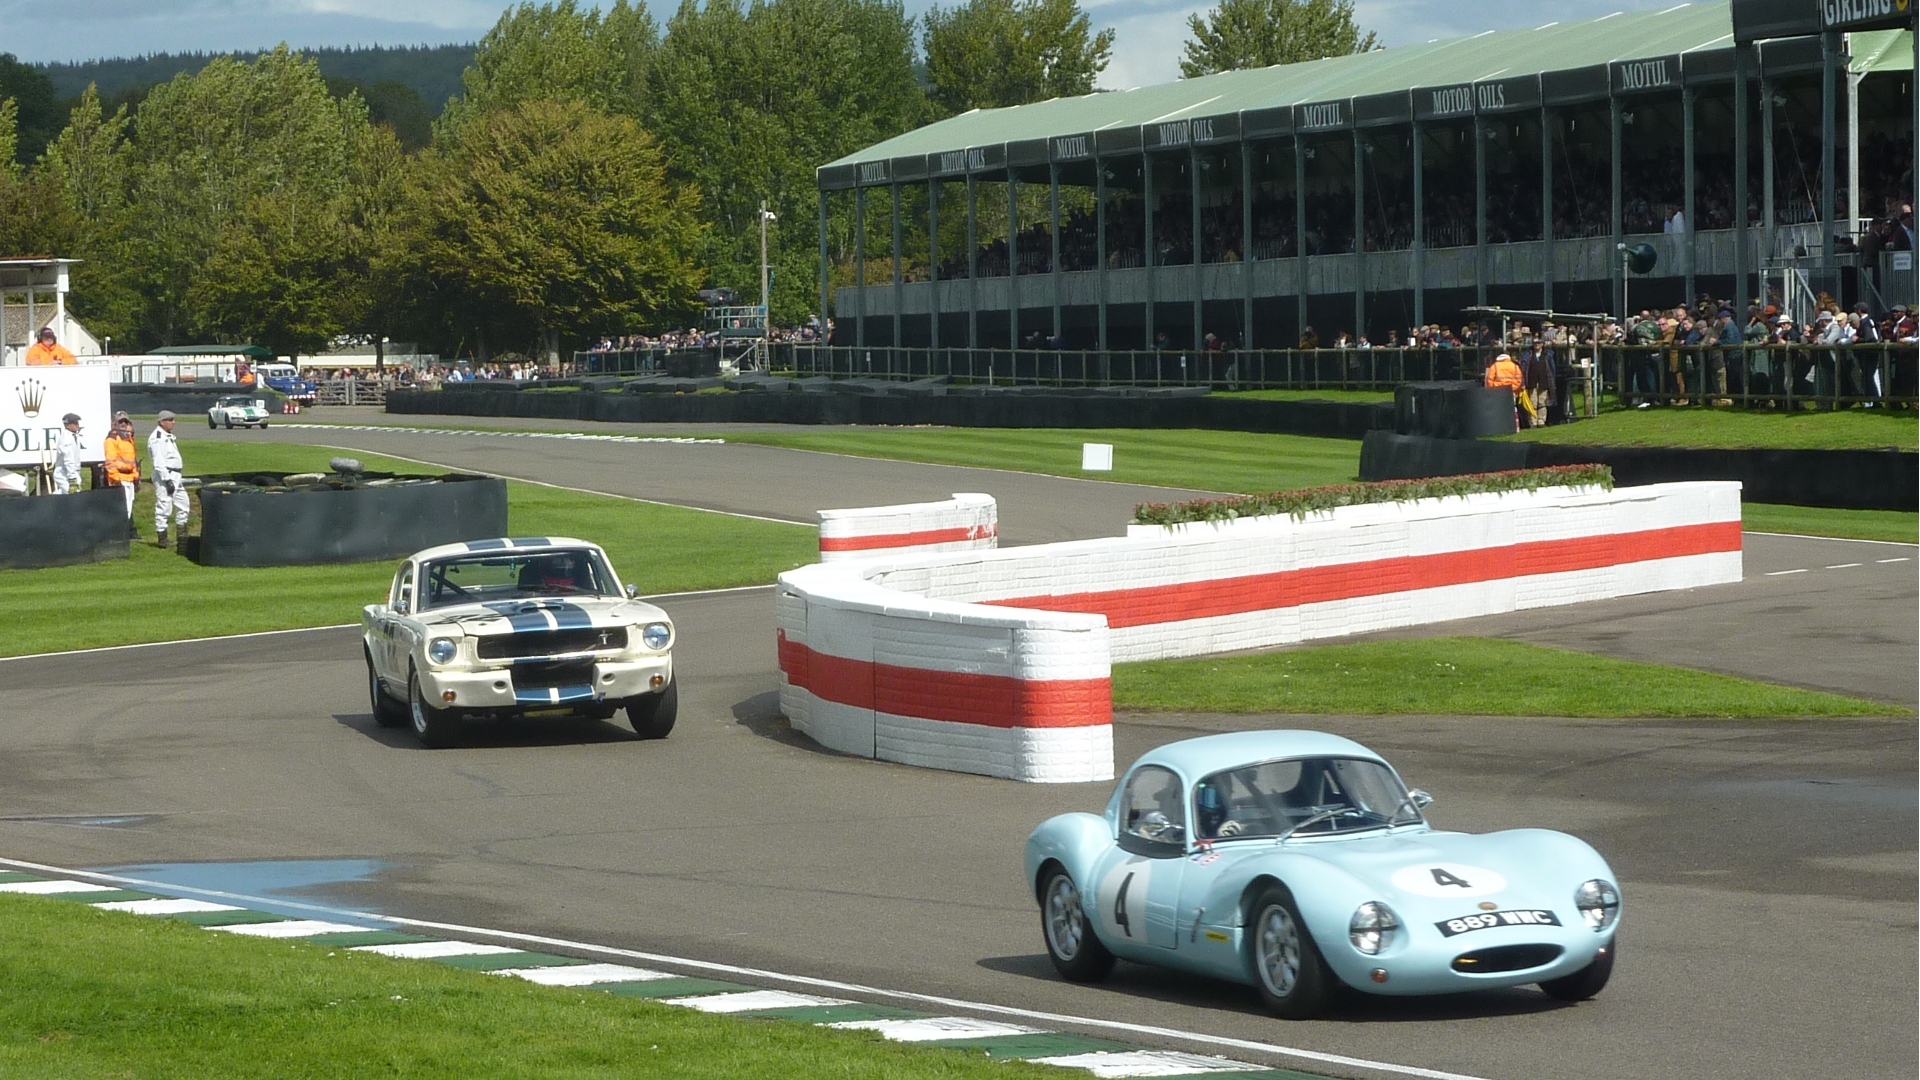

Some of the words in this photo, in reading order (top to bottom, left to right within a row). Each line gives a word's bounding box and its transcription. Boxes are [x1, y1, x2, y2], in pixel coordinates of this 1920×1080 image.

[1823, 0, 1891, 26] GIRLING
[1621, 60, 1670, 90] MOTUL
[1432, 87, 1472, 115] MOTOR
[1478, 84, 1505, 110] OILS
[1303, 103, 1343, 129] MOTUL
[1159, 121, 1190, 147] MOTOR
[1193, 119, 1214, 142] OILS
[1056, 136, 1089, 159] MOTUL
[861, 162, 887, 183] MOTUL
[940, 152, 966, 173] MOTOR
[969, 149, 986, 170] OILS
[1429, 868, 1473, 888] 4
[1114, 871, 1135, 938] 4
[1447, 913, 1498, 933] 889
